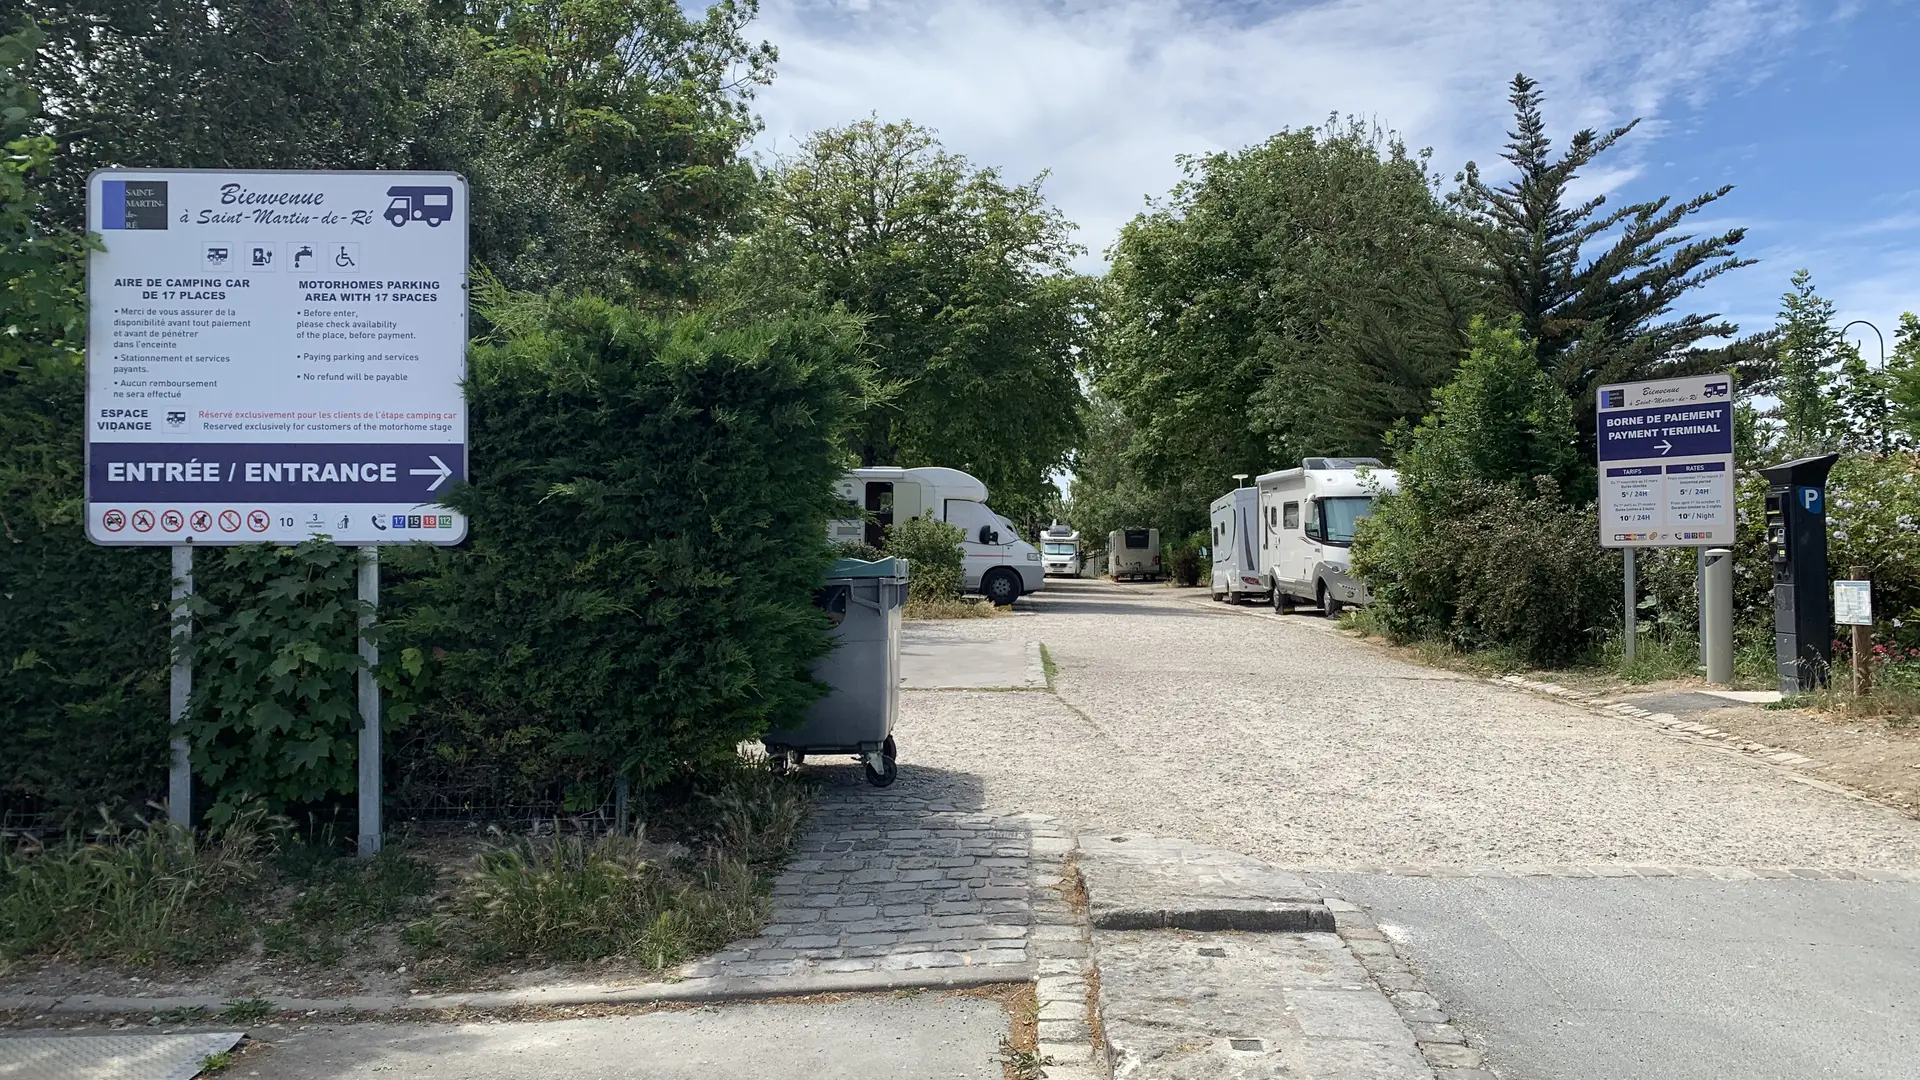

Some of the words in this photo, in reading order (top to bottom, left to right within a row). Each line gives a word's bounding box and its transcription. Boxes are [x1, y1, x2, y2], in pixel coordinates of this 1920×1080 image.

[220, 183, 324, 205] Bienvenue
[180, 209, 190, 223] à
[196, 208, 374, 225] Saint-Martin-de-Ré
[114, 279, 142, 288] AIRE
[147, 279, 162, 287] DE
[166, 279, 221, 288] CAMPING
[226, 280, 250, 288] CAR
[299, 281, 383, 290] MOTORHOMES
[388, 281, 440, 290] PARKING
[143, 291, 158, 300] DE
[180, 292, 225, 301] PLACES
[305, 293, 336, 302] AREA
[340, 293, 370, 302] WITH
[392, 294, 437, 303] SPACES
[334, 310, 358, 318] enter,
[114, 319, 165, 327] disponibilité
[212, 320, 250, 328] paiement
[297, 321, 324, 329] please
[352, 321, 397, 330] availability
[162, 330, 198, 338] pénétrer
[323, 332, 346, 340] place,
[378, 332, 416, 340] payment.
[121, 354, 182, 362] Stationnement
[304, 353, 330, 362] Paying
[334, 353, 364, 362] parking
[114, 366, 148, 374] payants.
[376, 374, 408, 382] payable
[147, 390, 181, 398] effectué
[1642, 386, 1680, 396] Bienvenue
[101, 409, 148, 418] ESPACE
[199, 410, 232, 418] Réservé
[406, 412, 441, 420] camping
[1606, 416, 1644, 427] BORNE
[1647, 414, 1661, 424] DE
[1664, 409, 1722, 422] PAIEMENT
[97, 421, 151, 431] VIDANGE
[204, 422, 242, 430] Reserved
[245, 423, 290, 432] exclusively
[430, 424, 452, 432] stage
[1608, 429, 1659, 441] PAYMENT
[1662, 424, 1721, 437] TERMINAL
[108, 458, 220, 482] ENTRÉE
[246, 463, 396, 482] ENTRANCE
[1805, 489, 1819, 509] P
[312, 513, 318, 522] 3
[394, 516, 404, 525] 17
[410, 516, 419, 525] 15
[425, 516, 435, 525] 18
[439, 516, 451, 525] 112
[1696, 512, 1715, 521] Night
[279, 517, 294, 527] 10
